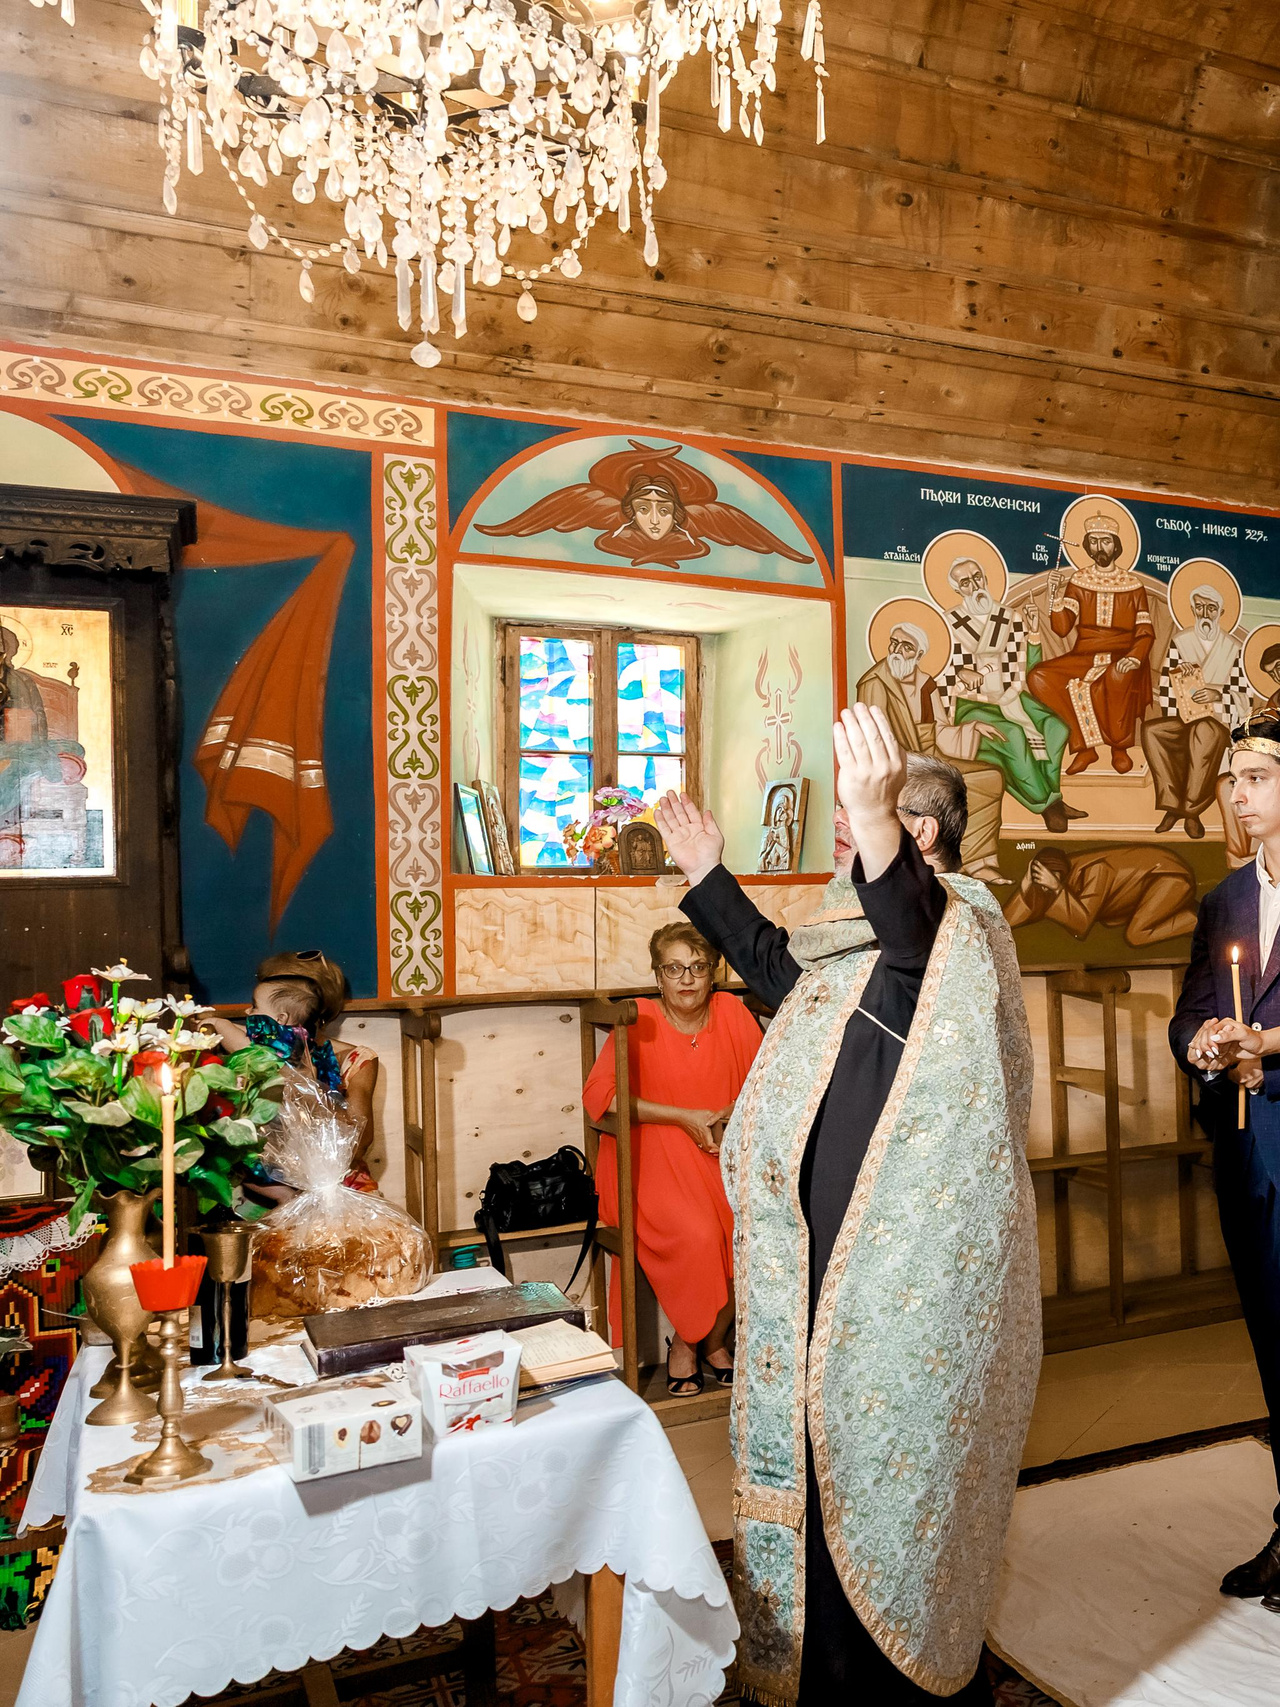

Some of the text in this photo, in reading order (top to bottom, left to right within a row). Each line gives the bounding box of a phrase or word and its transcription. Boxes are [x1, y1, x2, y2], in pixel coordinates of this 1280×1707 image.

[920, 488, 1041, 514] ПЪРВИ ВСЕЛЕНСКИ
[1156, 517, 1192, 539] СЪБОР
[1202, 523, 1238, 538] НИКЕЯ
[1032, 552, 1050, 566] ЦАР
[439, 1374, 510, 1399] Raffaello
